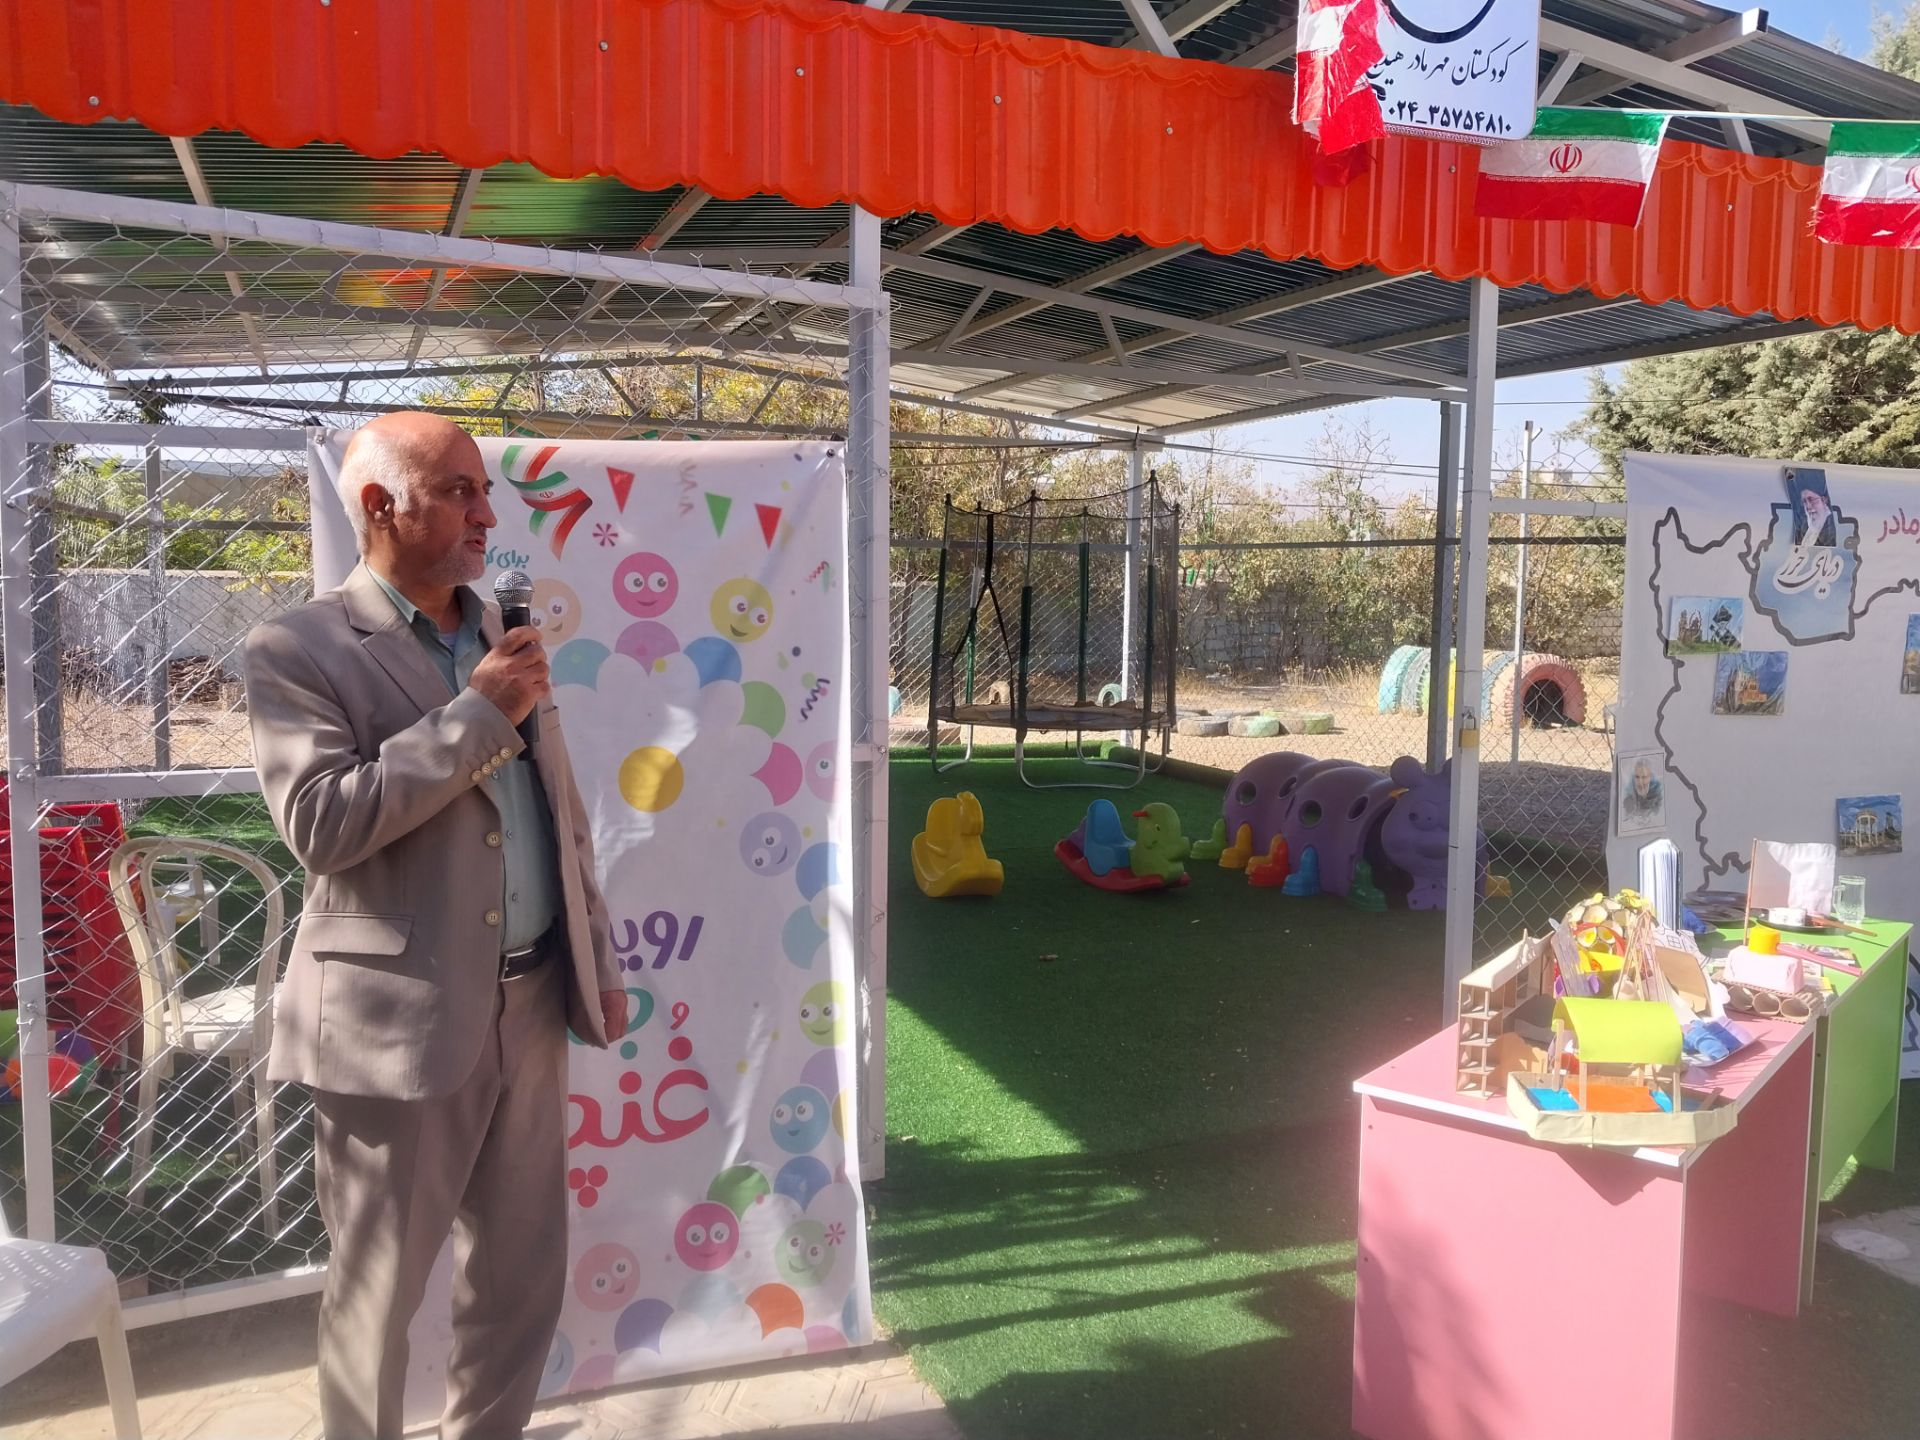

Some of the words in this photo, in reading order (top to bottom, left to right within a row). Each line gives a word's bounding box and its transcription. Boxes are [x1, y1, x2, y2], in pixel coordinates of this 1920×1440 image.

[1407, 48, 1428, 72] مادر
[1451, 37, 1529, 86] کودکستان
[496, 549, 530, 569] برای
[1777, 554, 1840, 594] دریای
